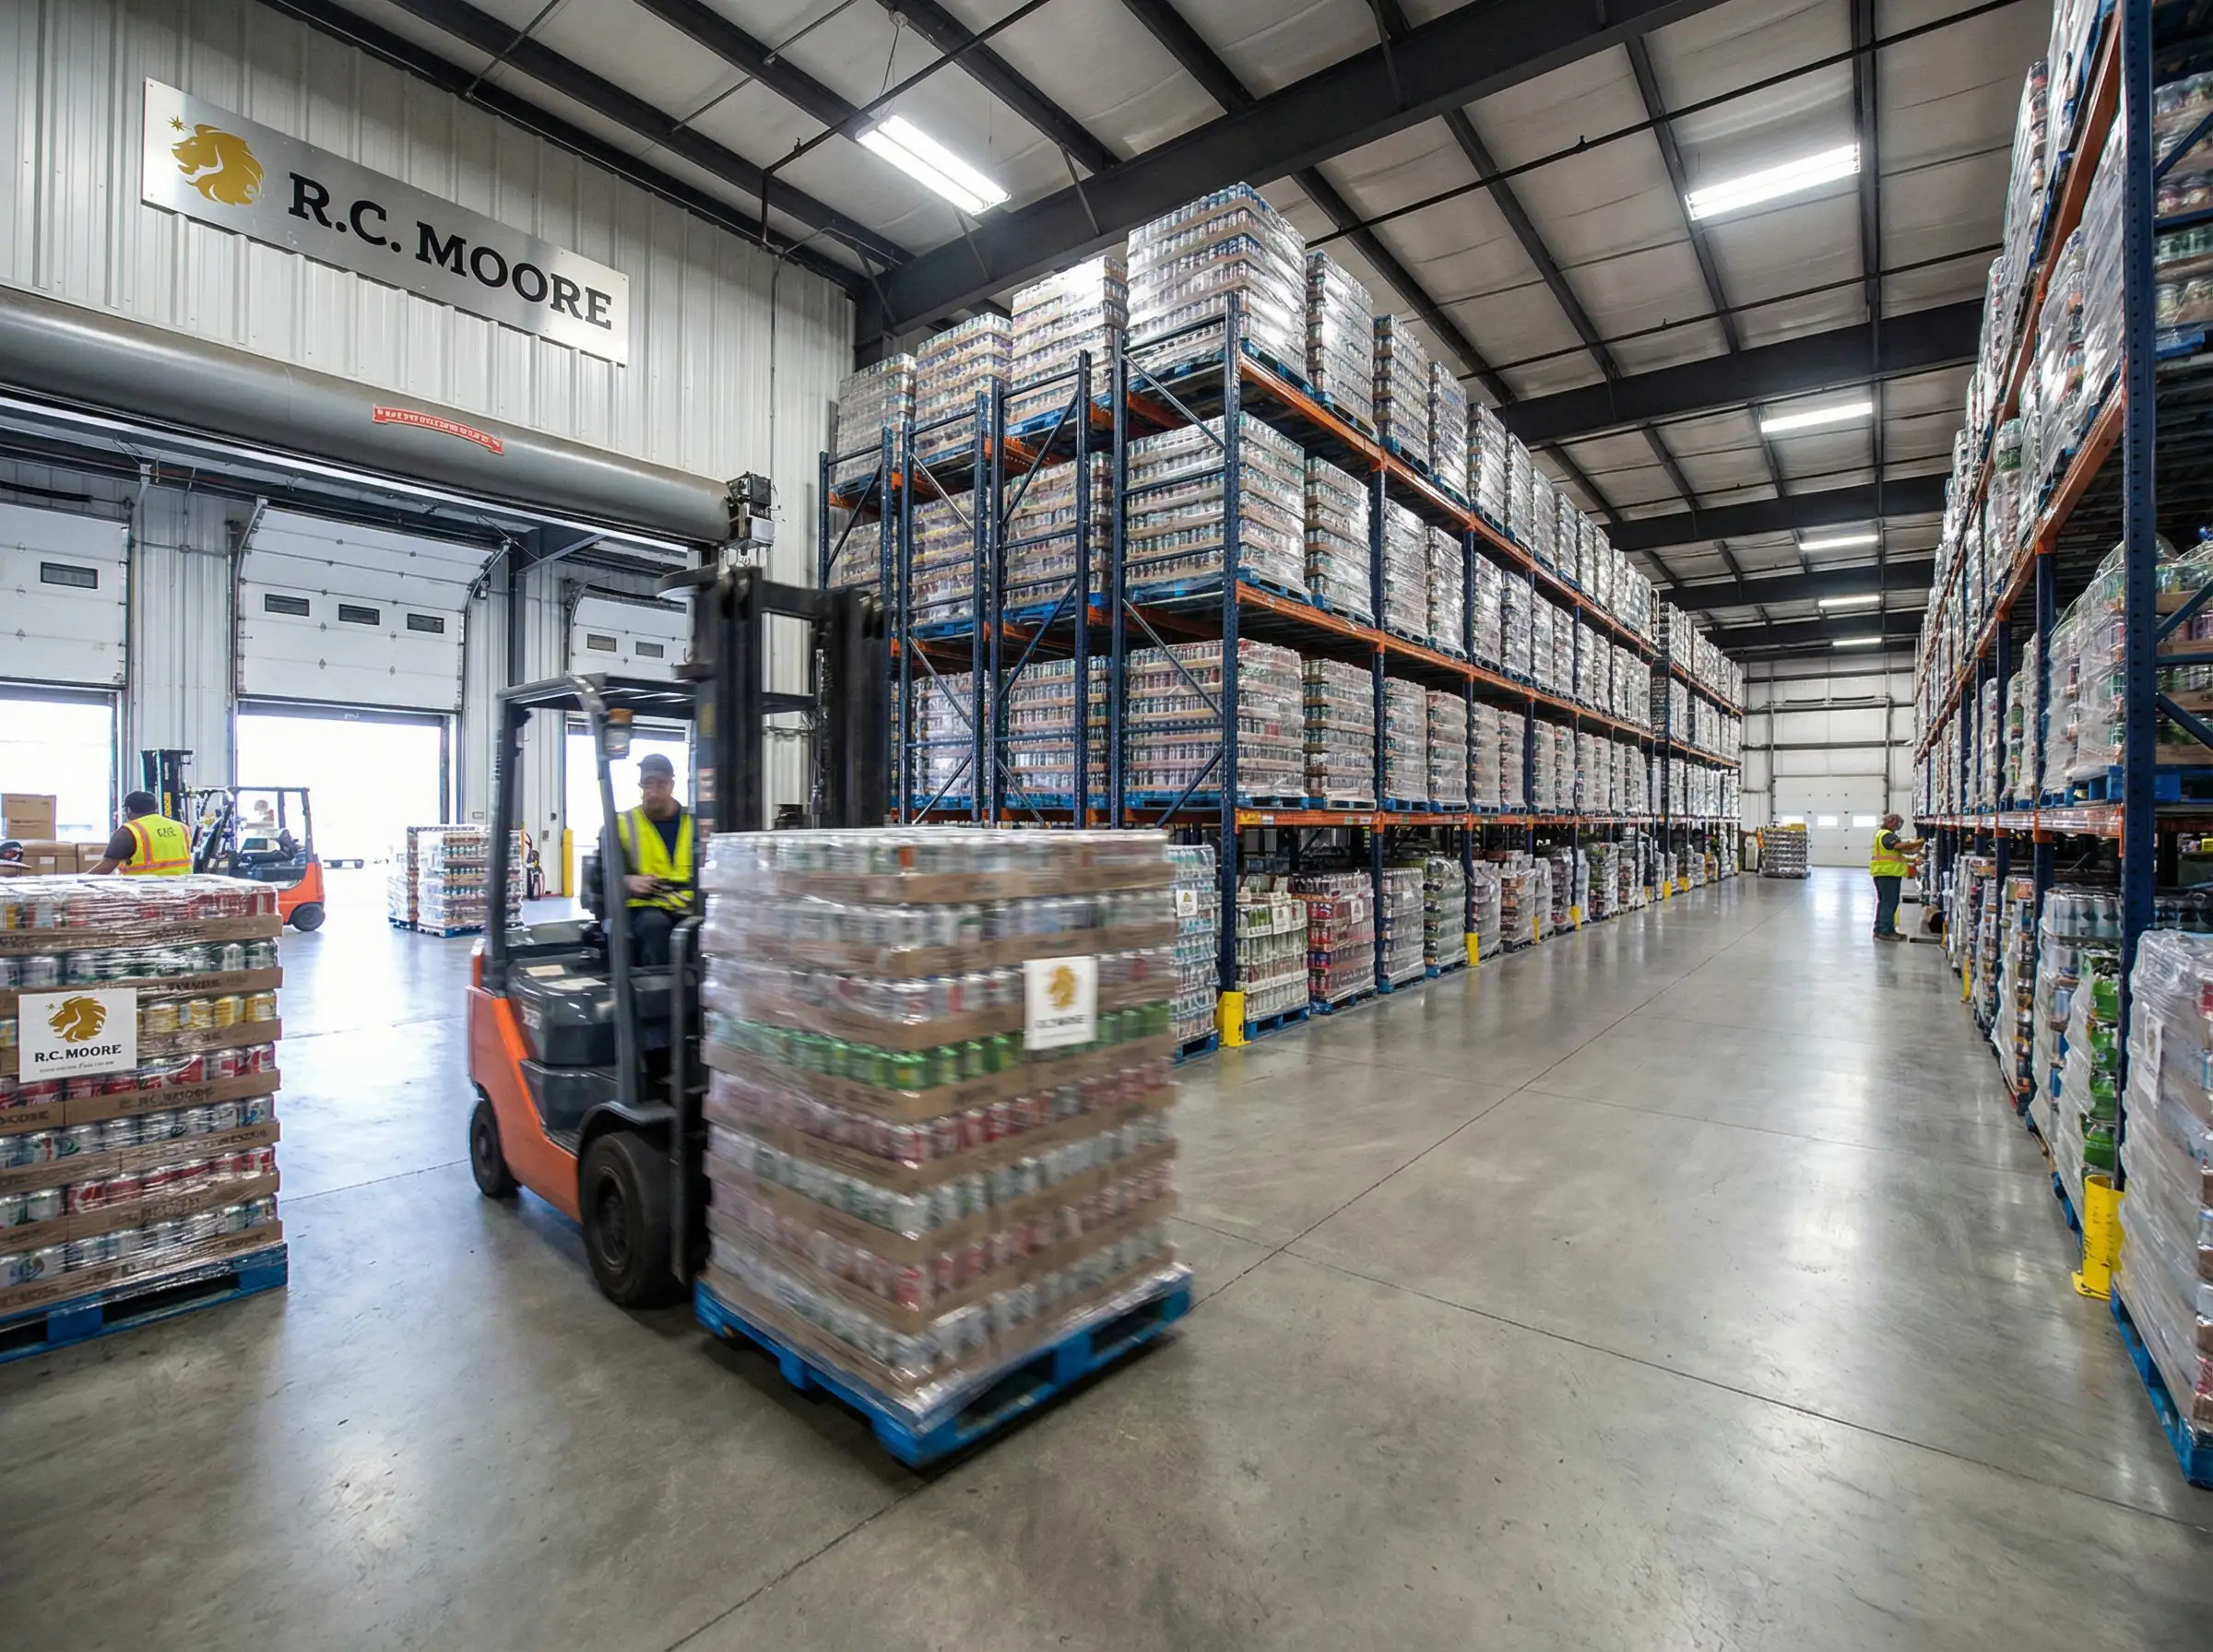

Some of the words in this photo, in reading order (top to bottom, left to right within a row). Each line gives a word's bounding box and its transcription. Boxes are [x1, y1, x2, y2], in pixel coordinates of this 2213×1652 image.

[288, 171, 402, 254] R.C.
[415, 220, 612, 331] MOORE
[34, 1051, 64, 1063] R.C.
[65, 1044, 122, 1059] MOORE
